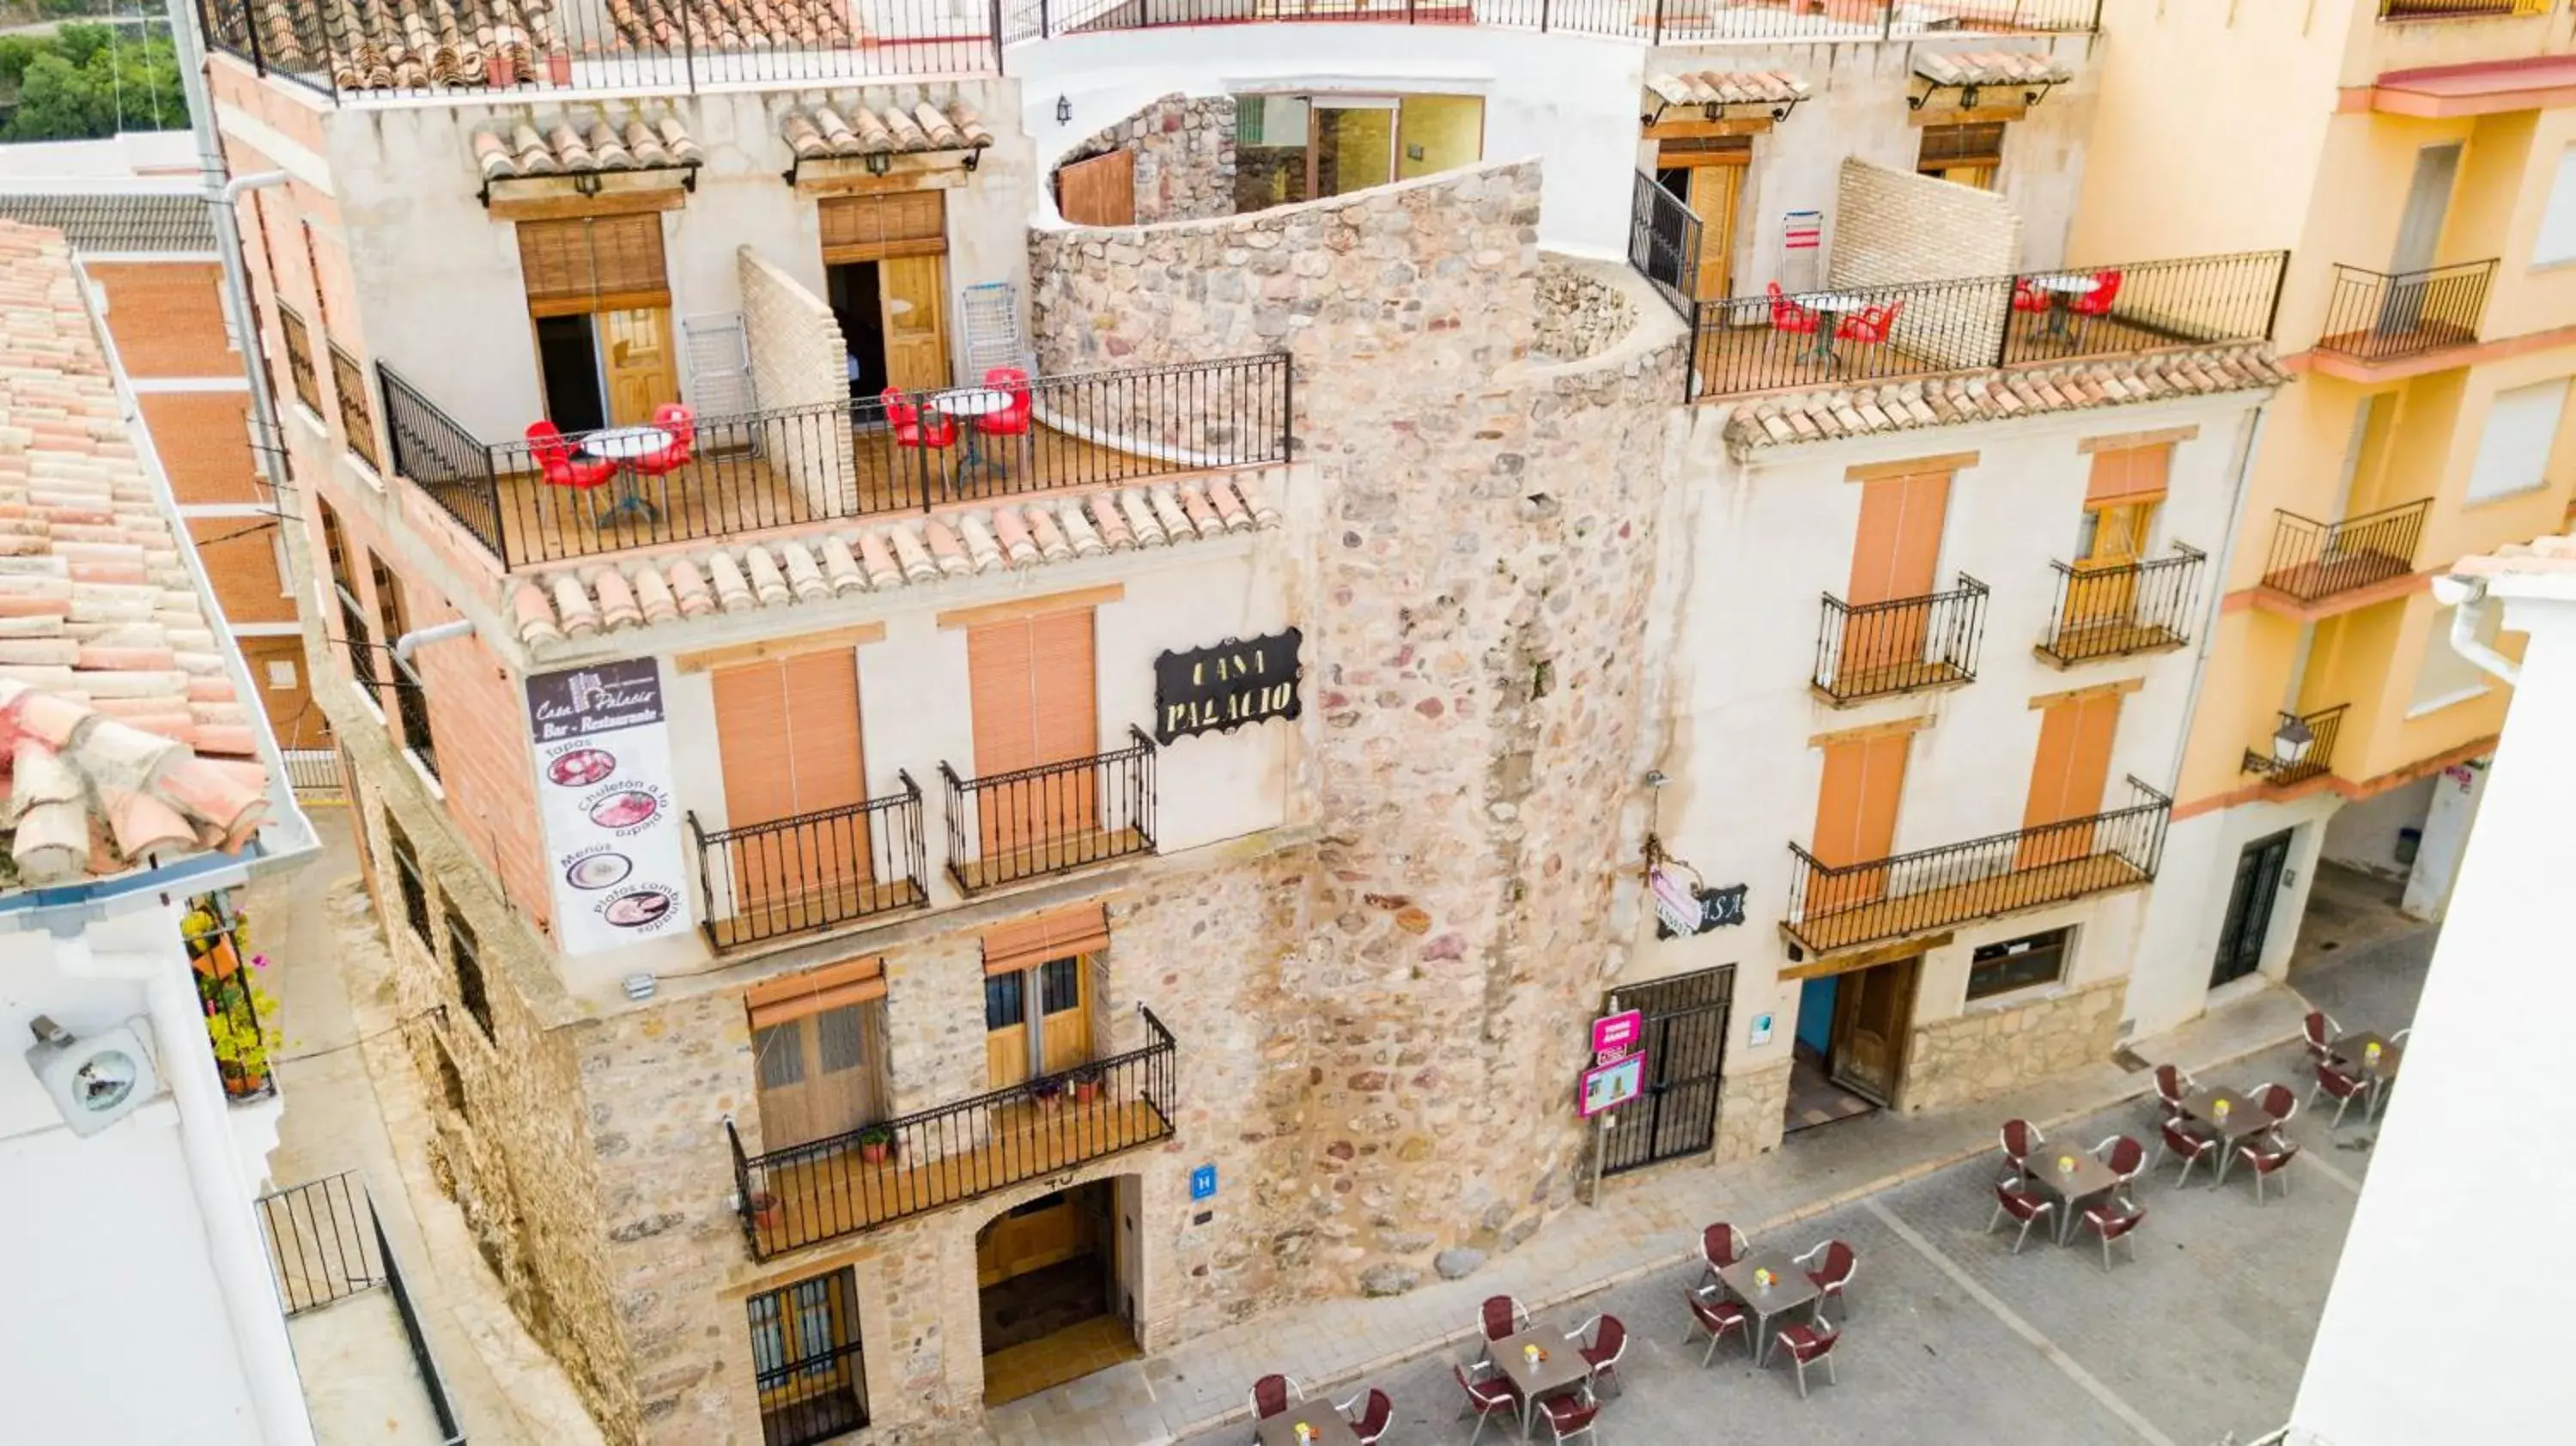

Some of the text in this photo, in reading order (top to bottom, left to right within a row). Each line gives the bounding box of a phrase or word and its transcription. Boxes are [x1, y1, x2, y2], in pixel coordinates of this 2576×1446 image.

[1194, 649, 1265, 685] CASA
[536, 691, 655, 720] Casa Palacio
[1167, 683, 1291, 732] PALACIO
[543, 720, 568, 739] Bar
[581, 709, 656, 732] Restaurante
[545, 739, 592, 756] Tapas
[1700, 894, 1741, 921] ASA
[1199, 1175, 1211, 1190] H
